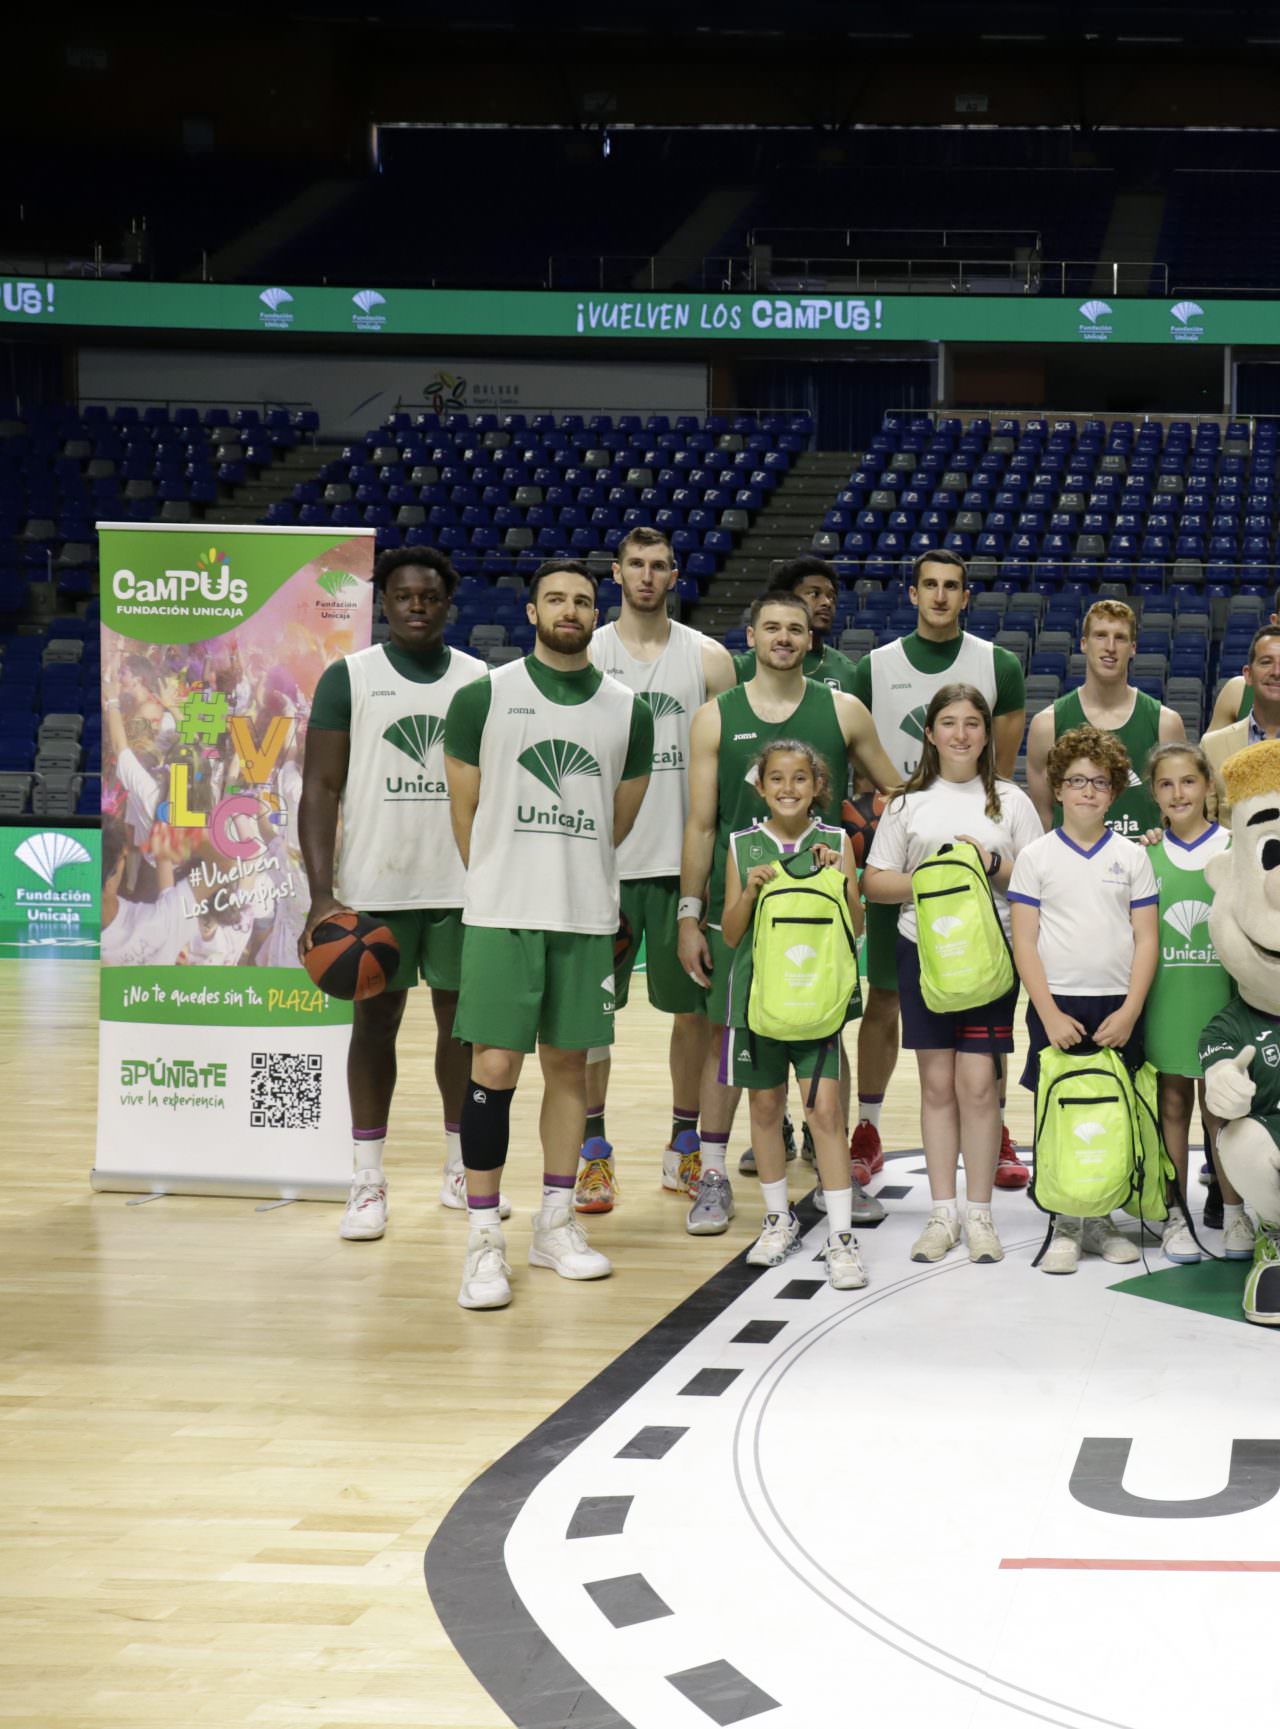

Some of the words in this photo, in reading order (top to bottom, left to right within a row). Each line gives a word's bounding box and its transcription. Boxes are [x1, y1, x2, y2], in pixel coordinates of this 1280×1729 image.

[576, 300, 690, 333] ¡VUELVEN
[700, 303, 742, 330] LOS
[116, 604, 189, 616] FUNDACIÓN
[192, 607, 243, 618] UNICAJA
[652, 744, 684, 767] caja
[386, 774, 450, 797] Unica
[517, 804, 596, 833] Unicaja
[1103, 813, 1139, 835] caja
[190, 857, 279, 889] #Vuelven
[16, 887, 92, 903] Fundación
[181, 898, 208, 919] Los
[214, 873, 296, 911] Campus!
[27, 908, 80, 923] Unicaja
[152, 984, 165, 1002] te
[171, 989, 220, 1010] quedes
[223, 990, 243, 1007] sin
[246, 986, 262, 1006] tu
[120, 1093, 144, 1106] vive
[148, 1090, 160, 1107] la
[163, 1091, 225, 1110] experiencia
